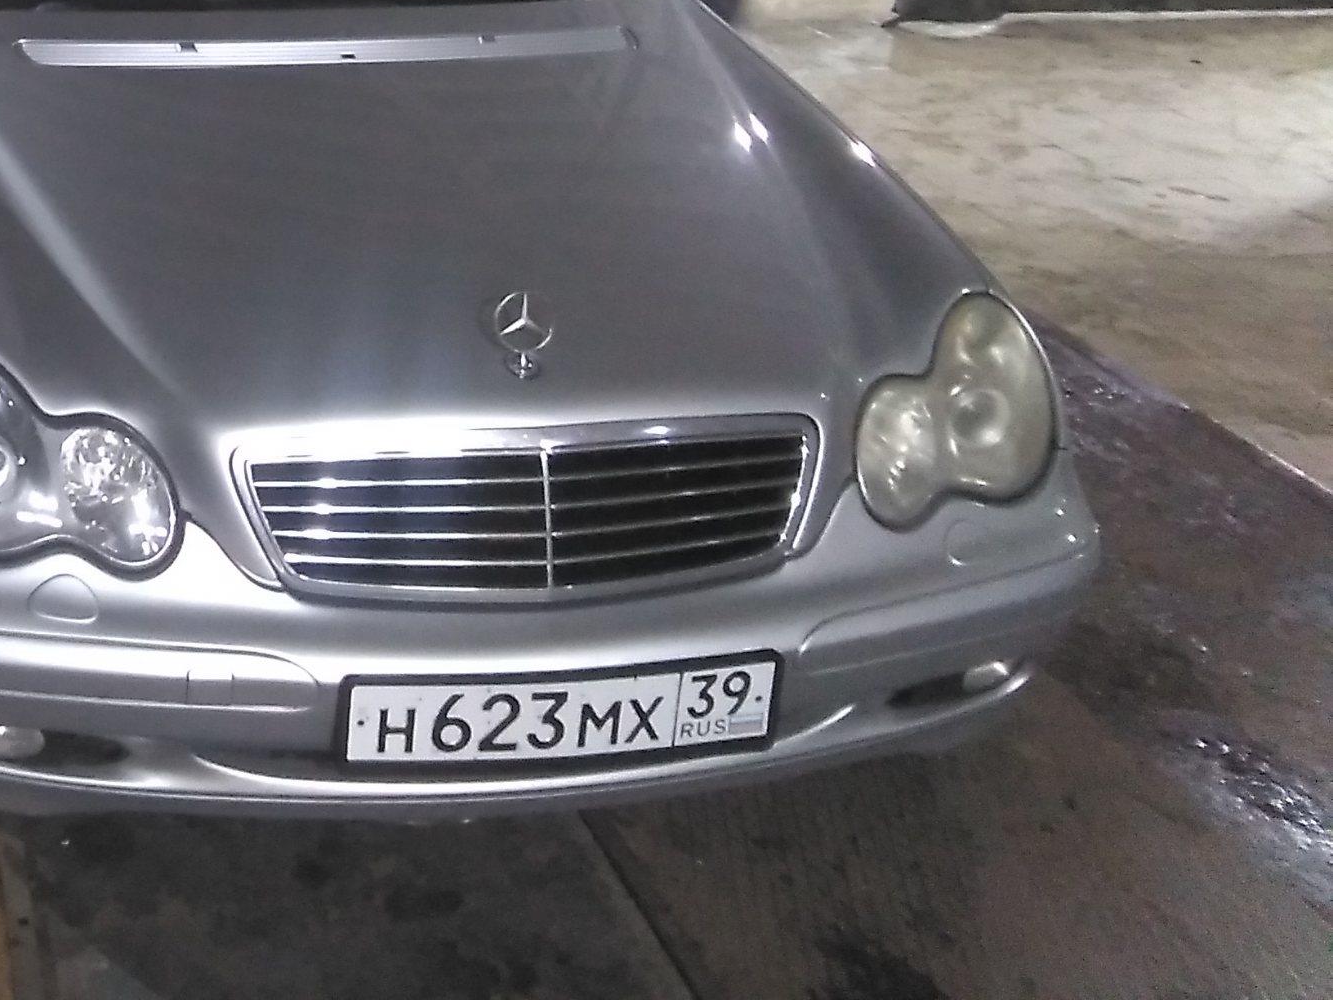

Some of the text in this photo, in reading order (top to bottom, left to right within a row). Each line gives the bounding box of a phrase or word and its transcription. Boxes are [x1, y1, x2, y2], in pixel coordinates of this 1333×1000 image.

[377, 671, 752, 754] Н623МХ 39
[680, 719, 727, 738] RUS
